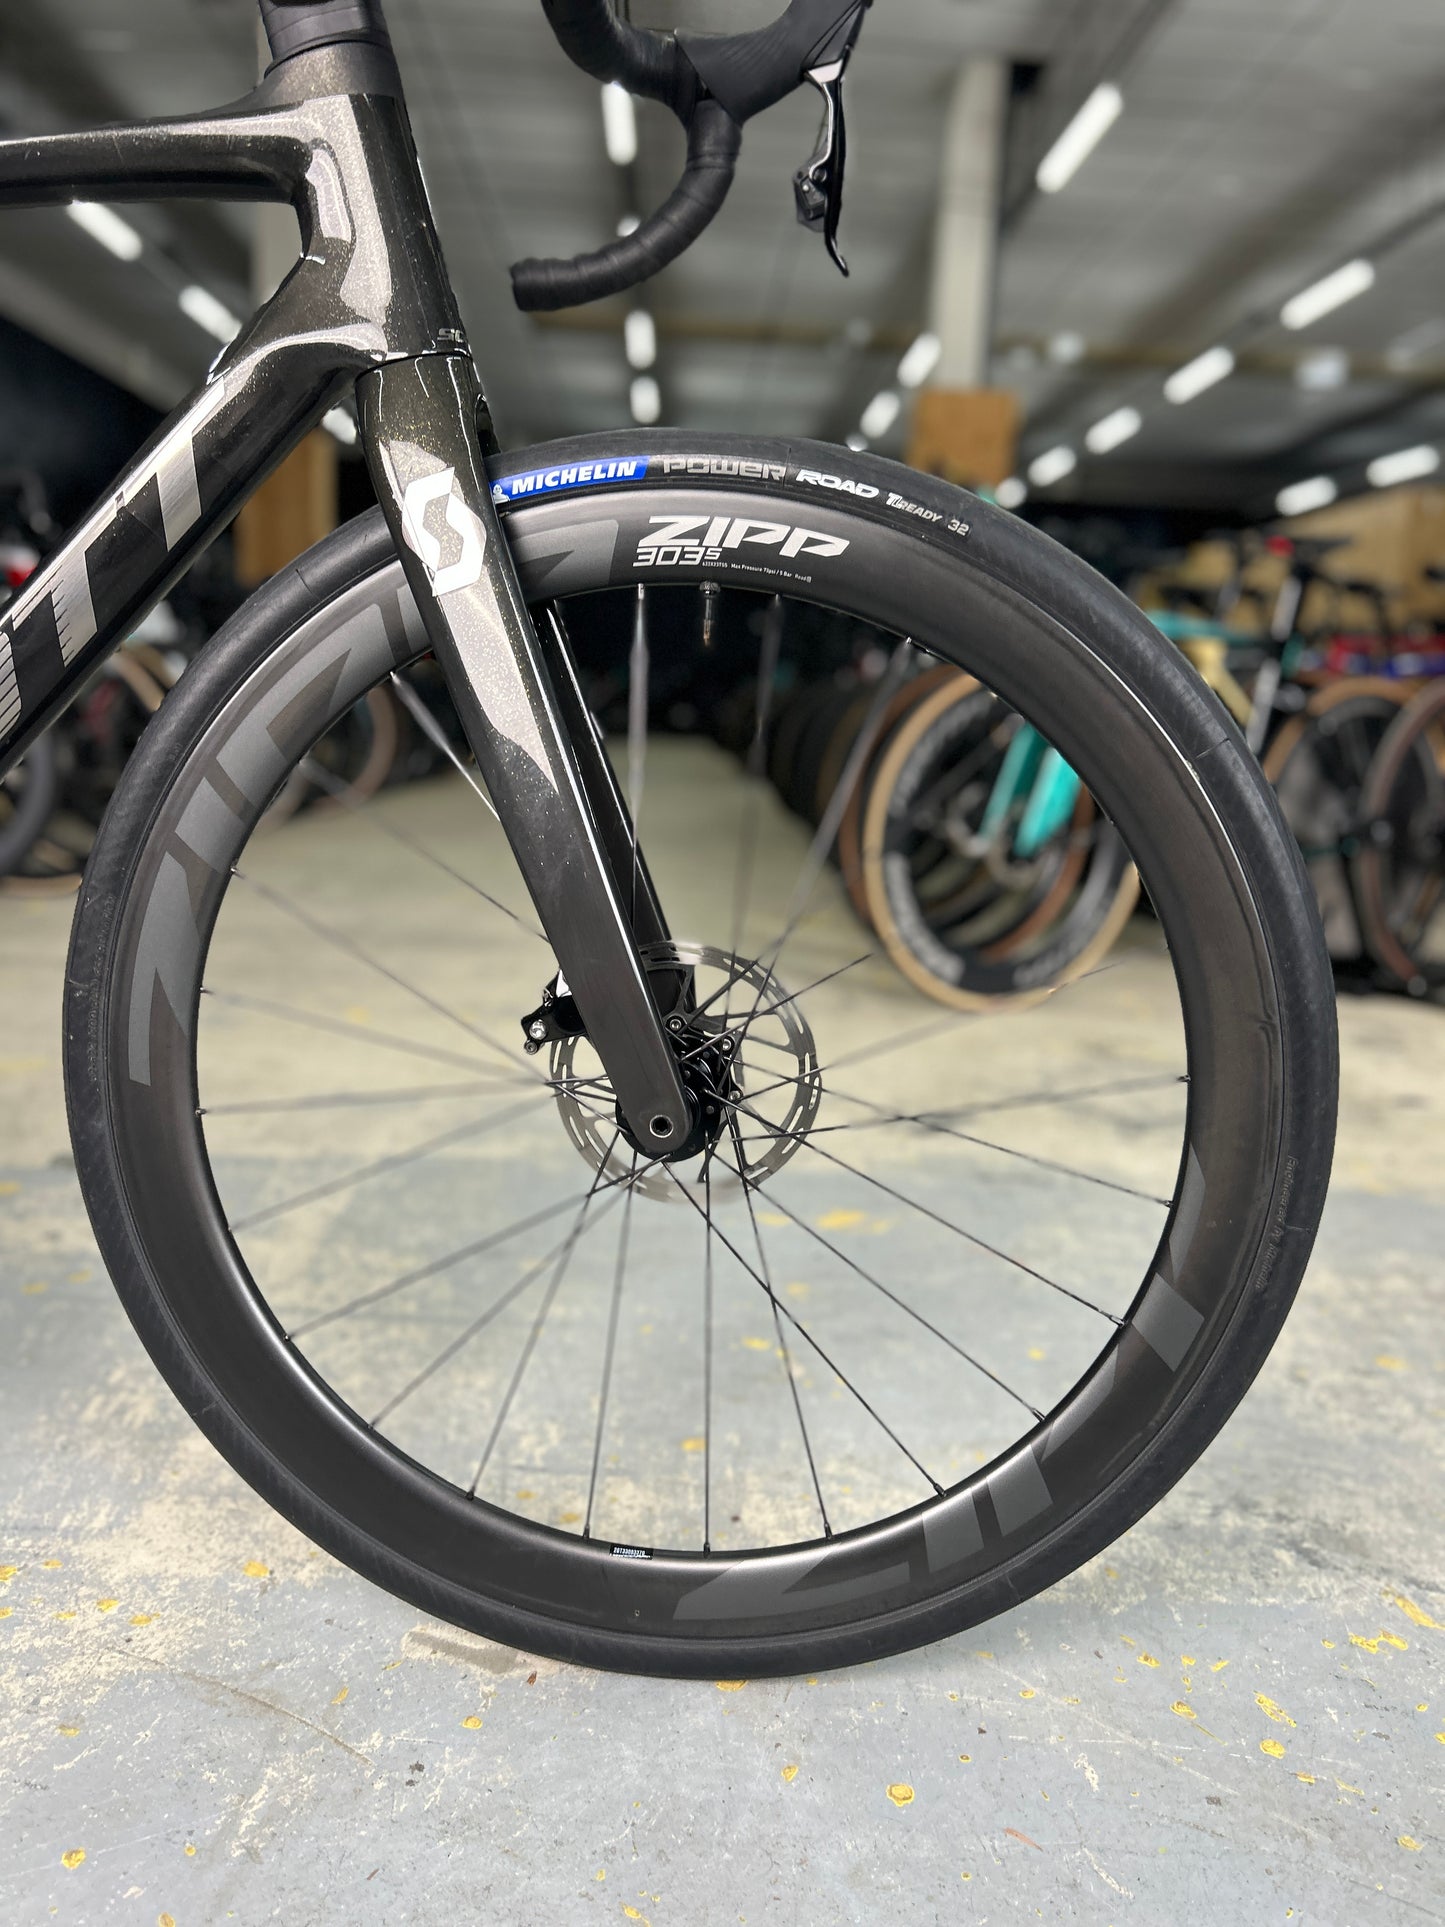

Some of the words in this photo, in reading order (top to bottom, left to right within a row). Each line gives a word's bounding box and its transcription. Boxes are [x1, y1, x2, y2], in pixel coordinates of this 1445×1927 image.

[511, 461, 637, 495] MICHELIN
[662, 458, 787, 481] POWER
[796, 469, 880, 498] ROAD
[948, 518, 970, 536] 32
[638, 515, 850, 558] ZIPP
